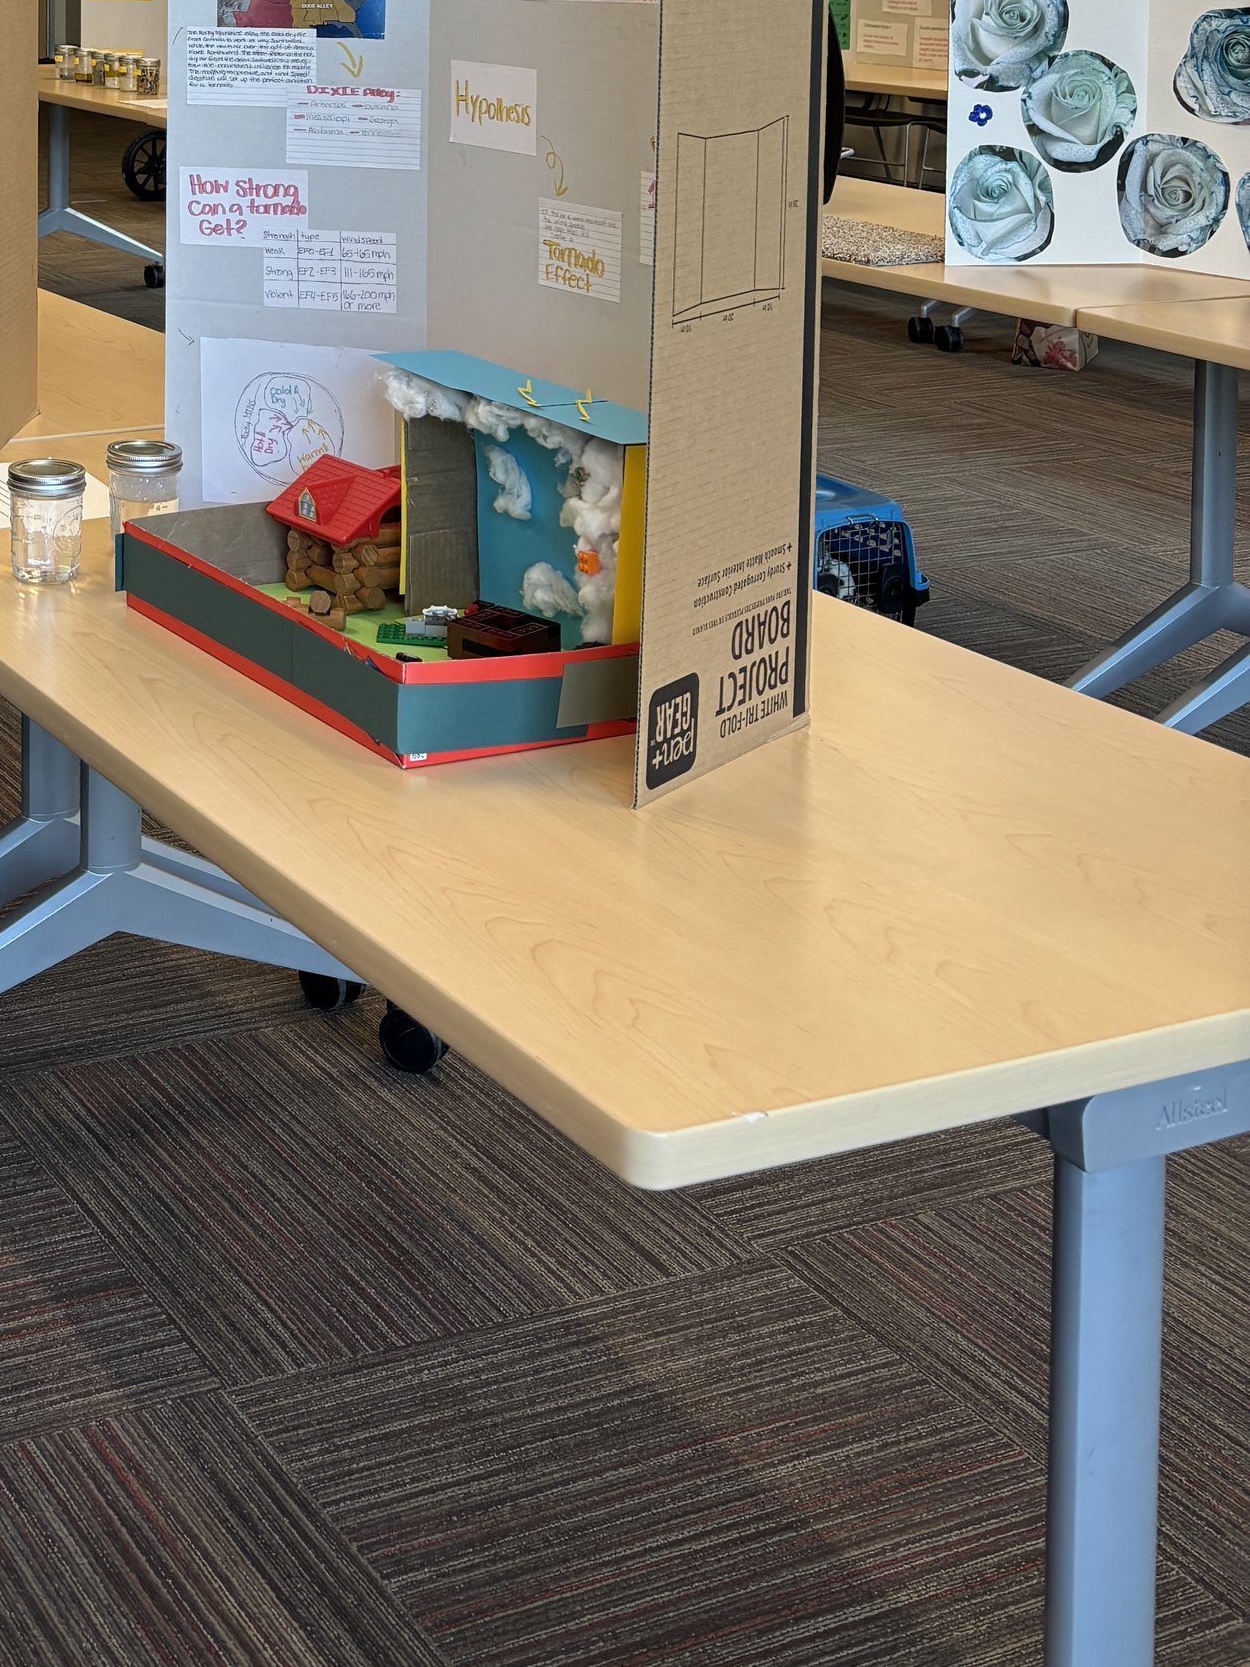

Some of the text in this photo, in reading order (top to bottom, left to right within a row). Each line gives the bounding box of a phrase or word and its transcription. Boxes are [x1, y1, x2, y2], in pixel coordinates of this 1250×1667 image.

[455, 80, 531, 126] Hypothesis
[229, 202, 243, 216] a
[376, 268, 394, 282] mph
[358, 302, 381, 310] more
[271, 396, 286, 408] Dry
[264, 438, 278, 454] Dry
[694, 562, 785, 608] Sturdy Corrugated Construction
[697, 544, 786, 588] Smooth Matte Interior Surface
[731, 599, 791, 660] BOARD
[715, 646, 790, 718] PROJECT
[656, 692, 692, 744] GEAR
[719, 690, 789, 739] WHITE TRI-FOLD
[651, 718, 695, 771] pen+
